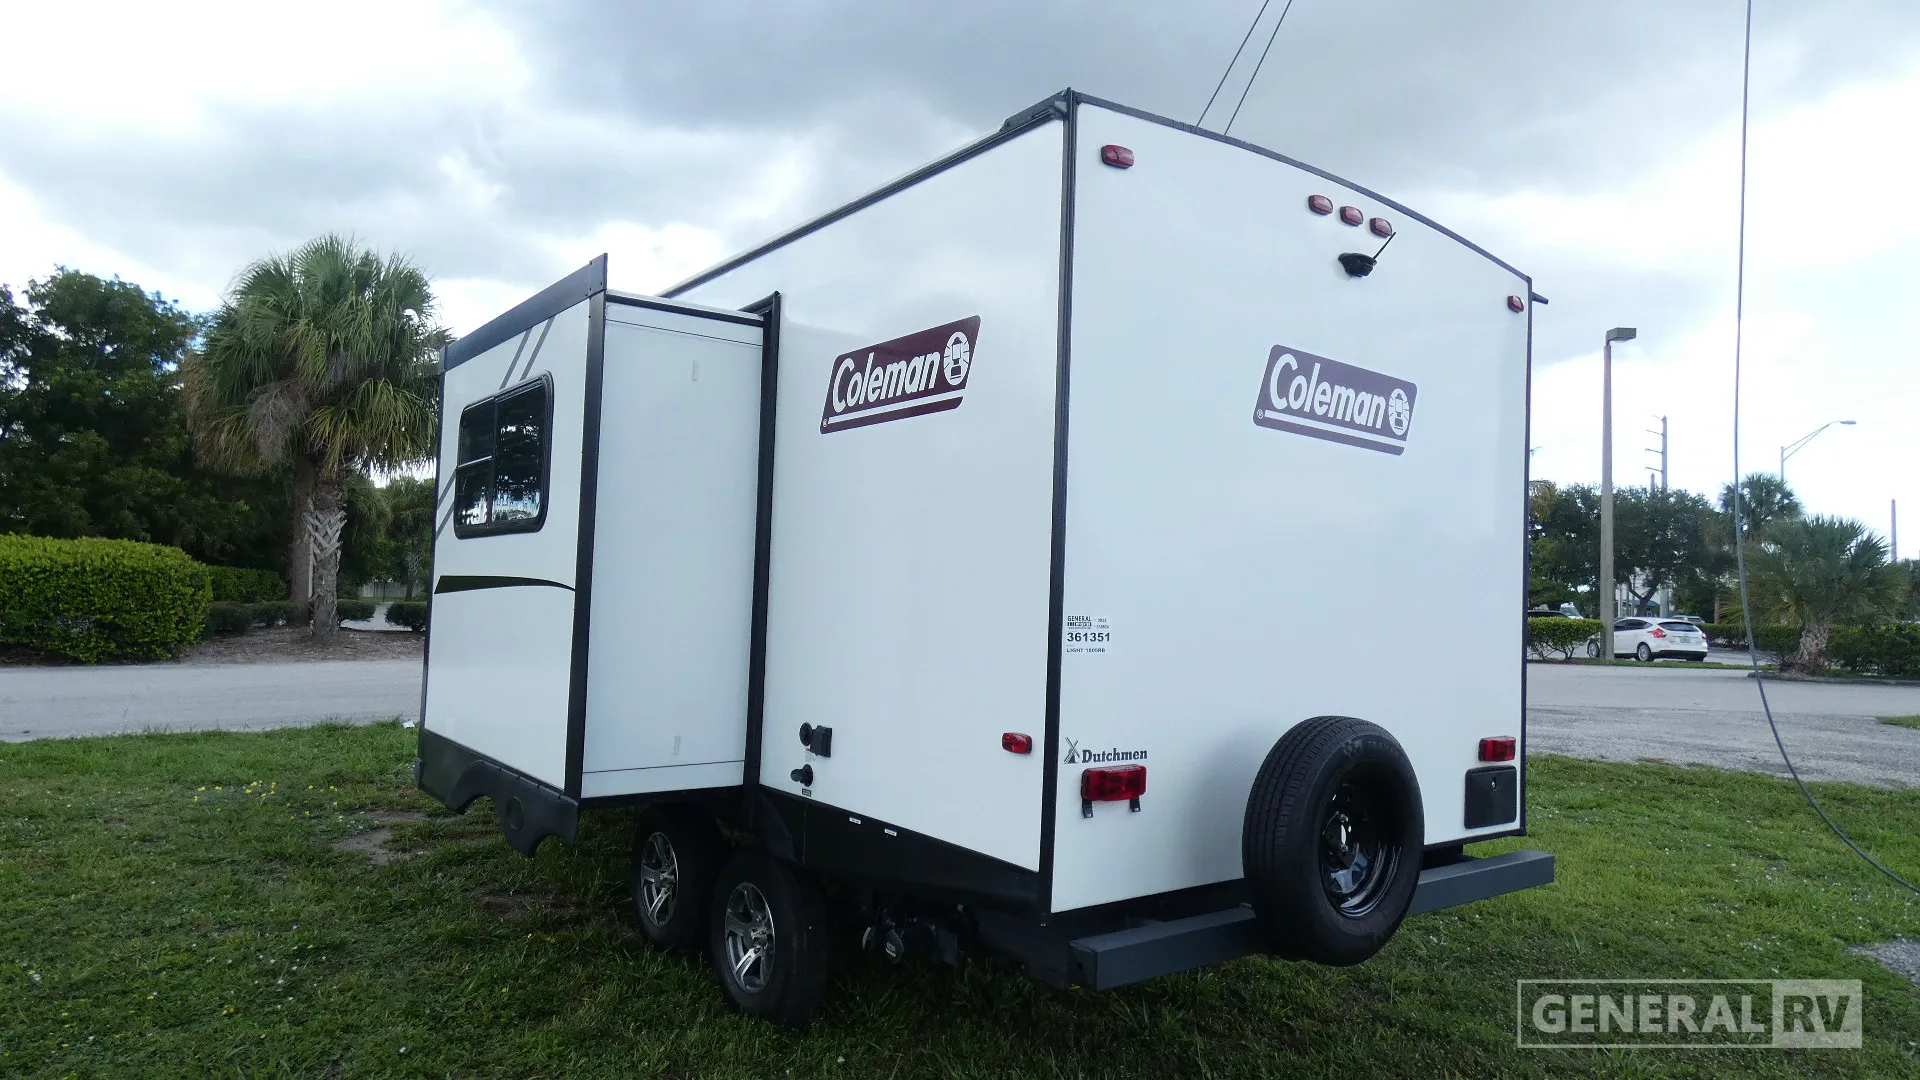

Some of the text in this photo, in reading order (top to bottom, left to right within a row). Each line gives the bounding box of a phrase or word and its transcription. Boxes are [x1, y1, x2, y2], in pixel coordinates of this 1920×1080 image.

[832, 351, 941, 413] Coleman
[1269, 353, 1386, 429] Coleman
[1066, 632, 1111, 642] 361351
[1081, 747, 1148, 763] Dutchmen
